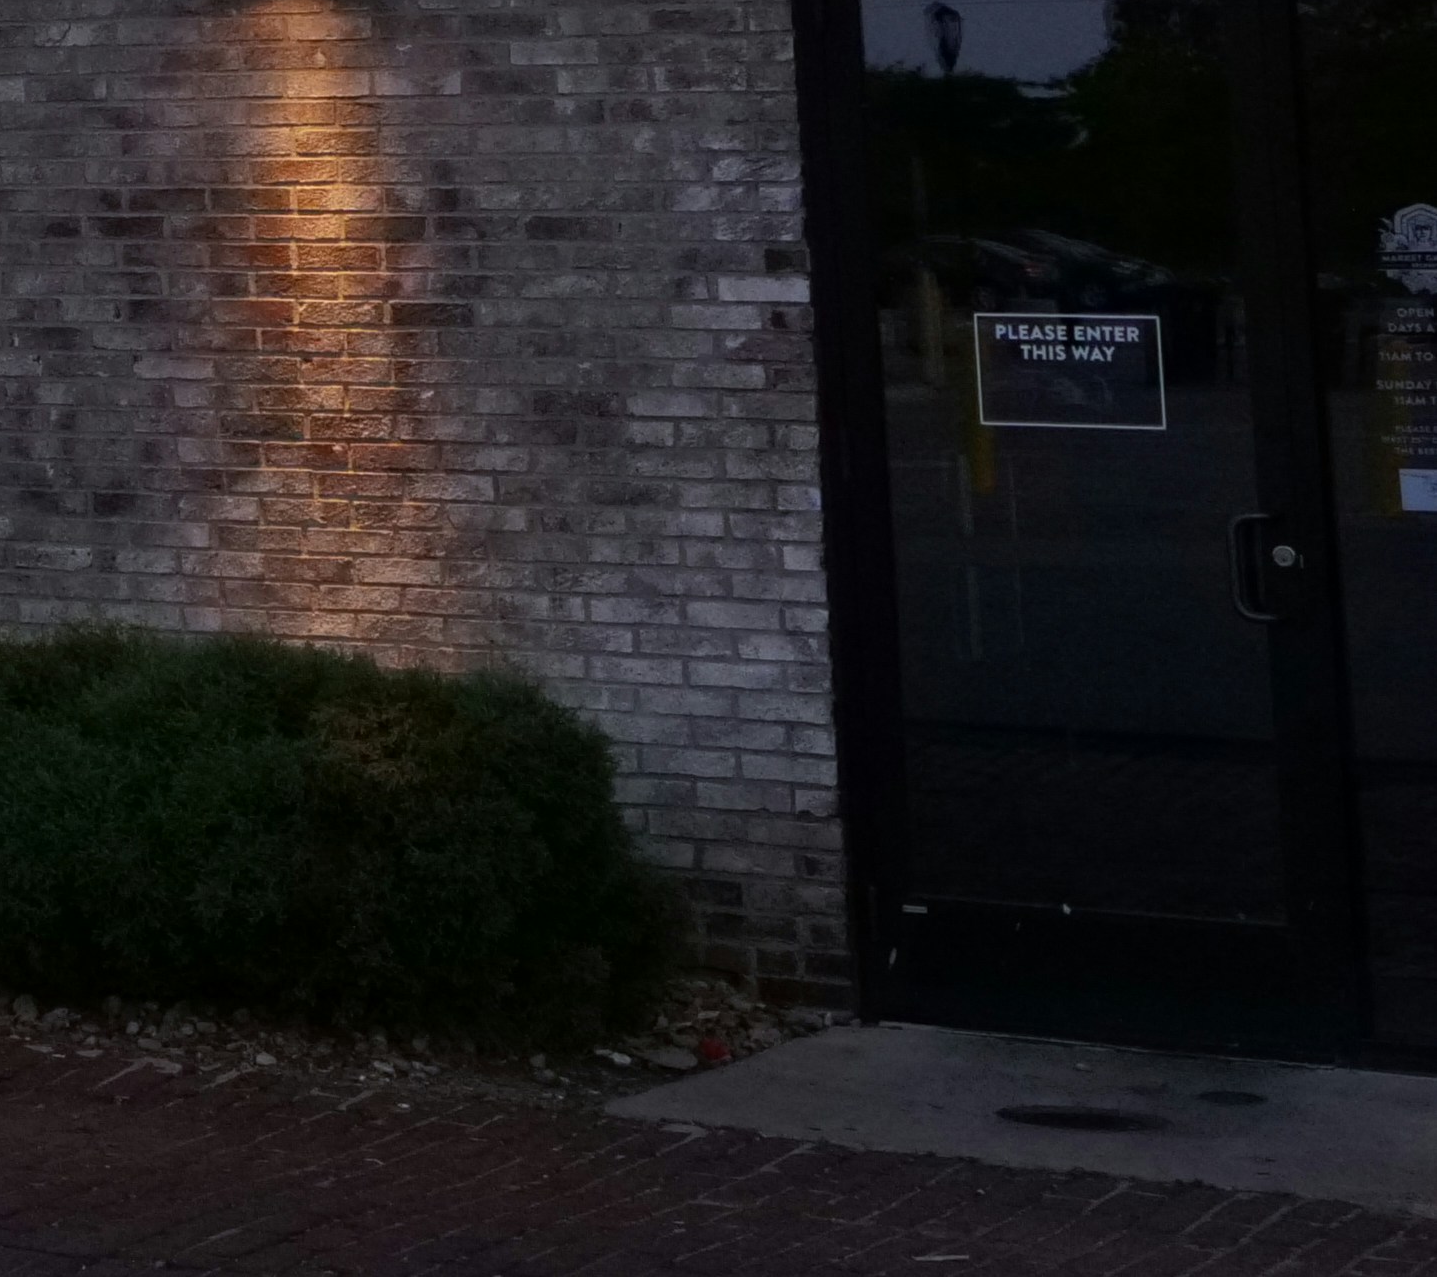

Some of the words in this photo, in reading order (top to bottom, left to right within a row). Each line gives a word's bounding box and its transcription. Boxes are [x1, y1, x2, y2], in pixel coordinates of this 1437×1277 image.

[1396, 307, 1435, 318] OPEN
[995, 324, 1069, 342] PLEASE
[1074, 326, 1140, 344] ENTER
[1387, 323, 1423, 333] DAYS
[1020, 344, 1067, 361] THIS
[1072, 345, 1116, 363] WAY
[1376, 379, 1432, 391] SUNDAY
